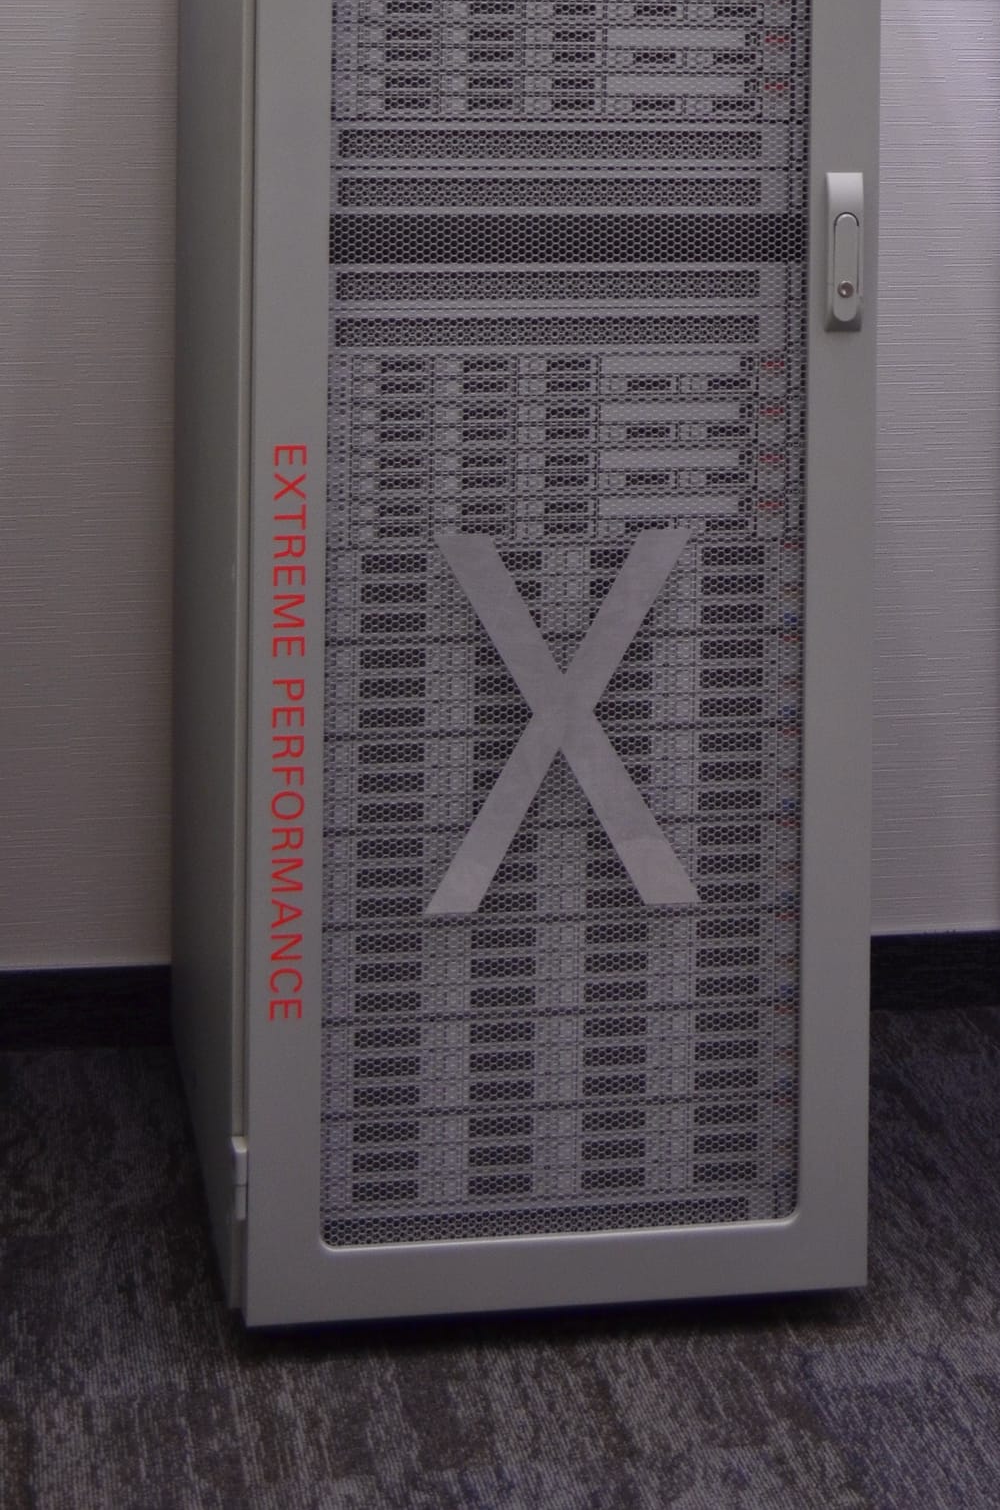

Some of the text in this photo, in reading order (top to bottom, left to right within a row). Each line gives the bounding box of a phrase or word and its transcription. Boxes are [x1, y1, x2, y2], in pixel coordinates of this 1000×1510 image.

[267, 443, 309, 1022] EXTREME PERFORMANCE
[425, 528, 699, 914] X
